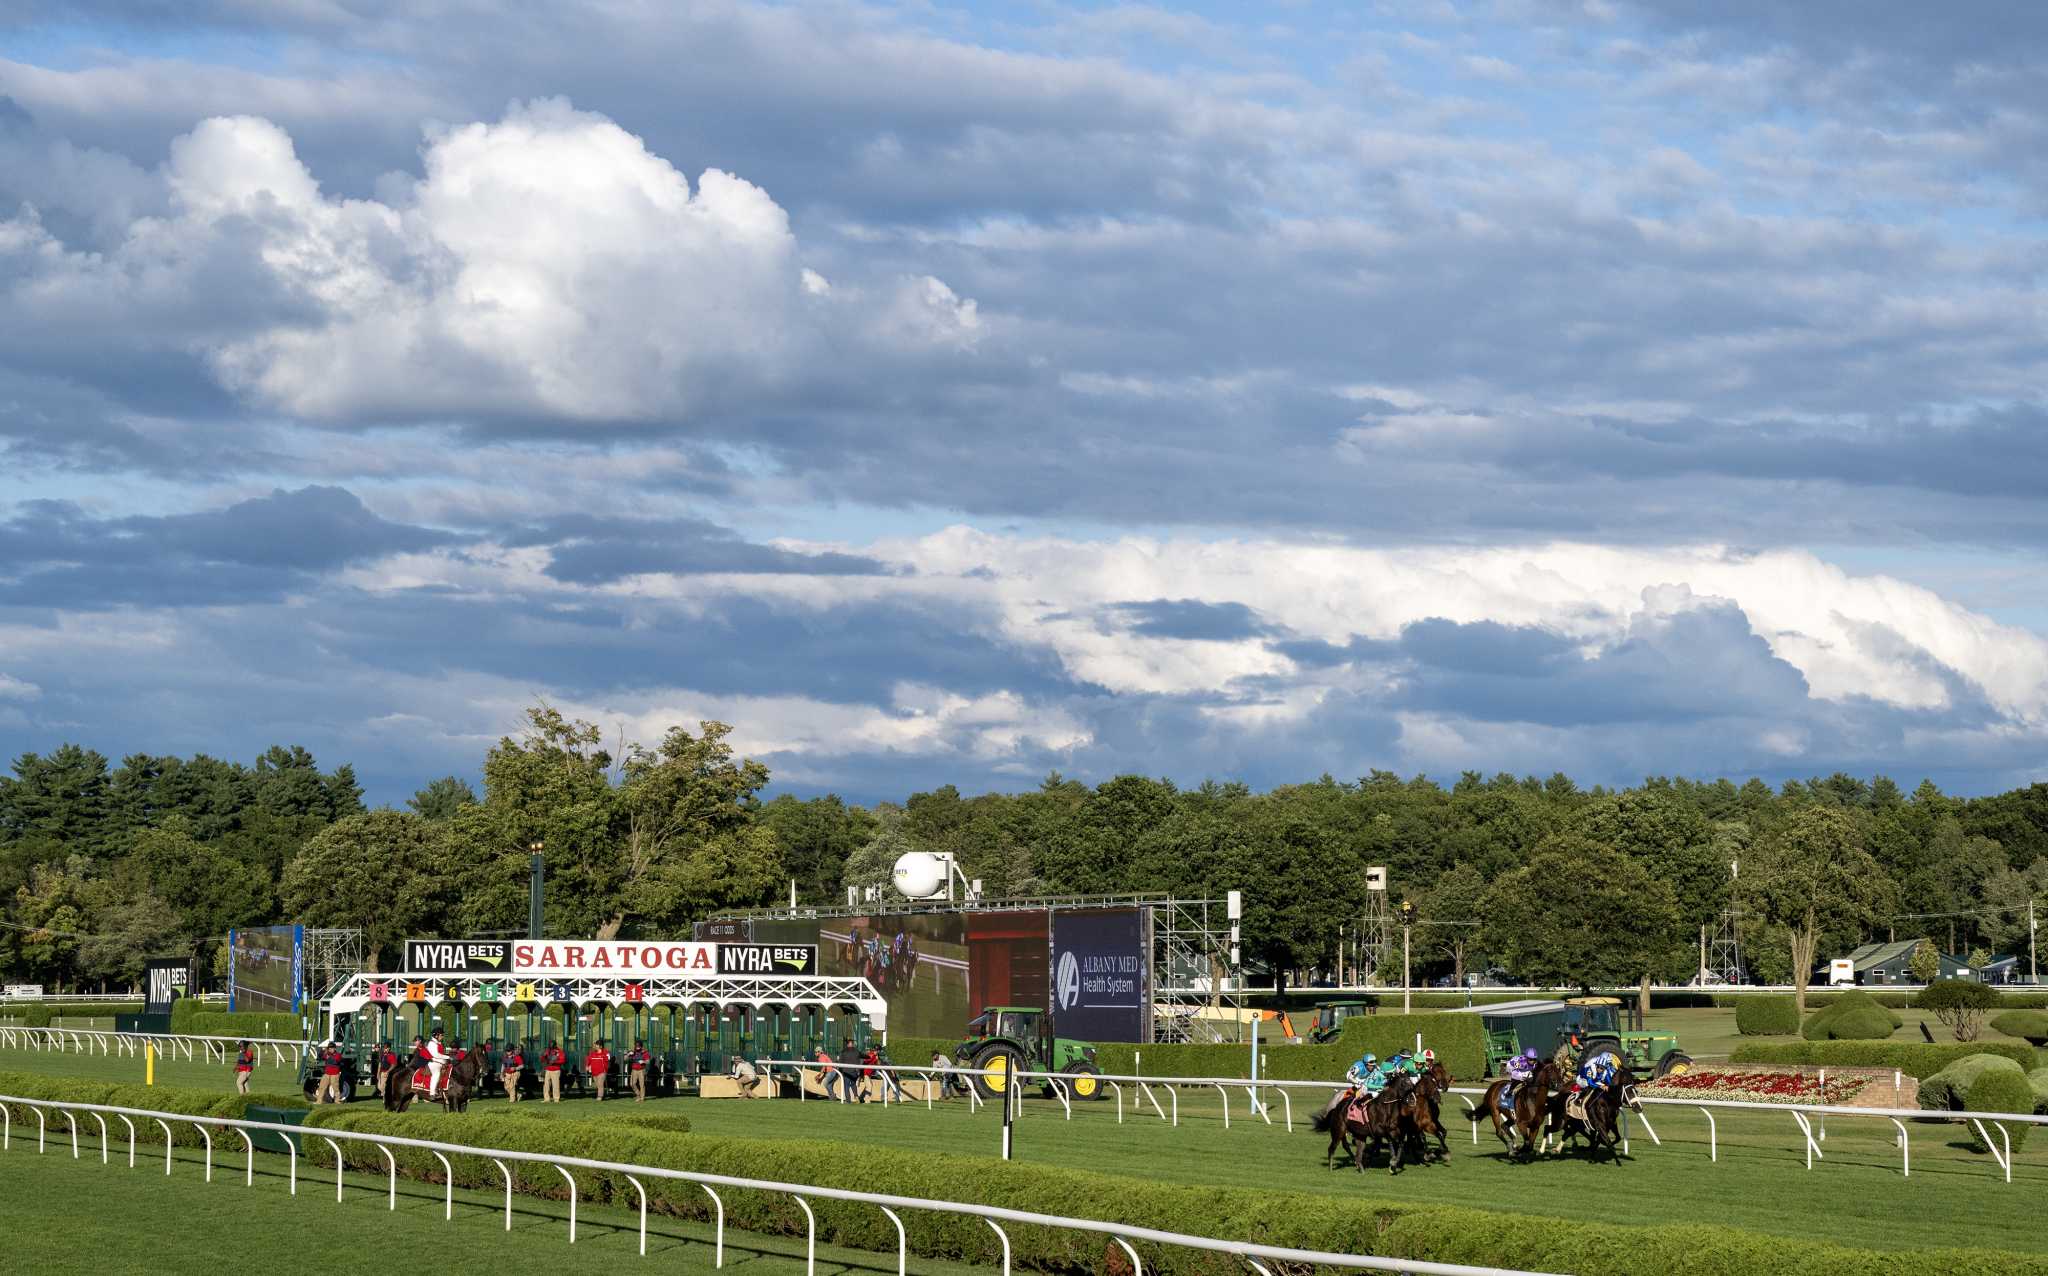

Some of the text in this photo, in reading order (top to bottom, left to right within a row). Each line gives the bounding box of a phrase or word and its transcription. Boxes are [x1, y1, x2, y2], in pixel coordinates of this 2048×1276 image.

[415, 945, 504, 969] NYRA BETS
[515, 945, 713, 969] SARATOGA
[724, 947, 808, 971] NYRA BETS
[1083, 956, 1138, 972] ALBANY MED
[150, 967, 187, 1003] NYRA BETS
[1083, 976, 1134, 996] Health System
[375, 987, 382, 998] 8
[412, 987, 419, 998] 7
[448, 986, 457, 998] 6
[485, 987, 493, 998] 5
[520, 987, 528, 998] 4
[558, 987, 566, 998] 3
[593, 987, 603, 998] 2
[631, 987, 637, 998] 1
